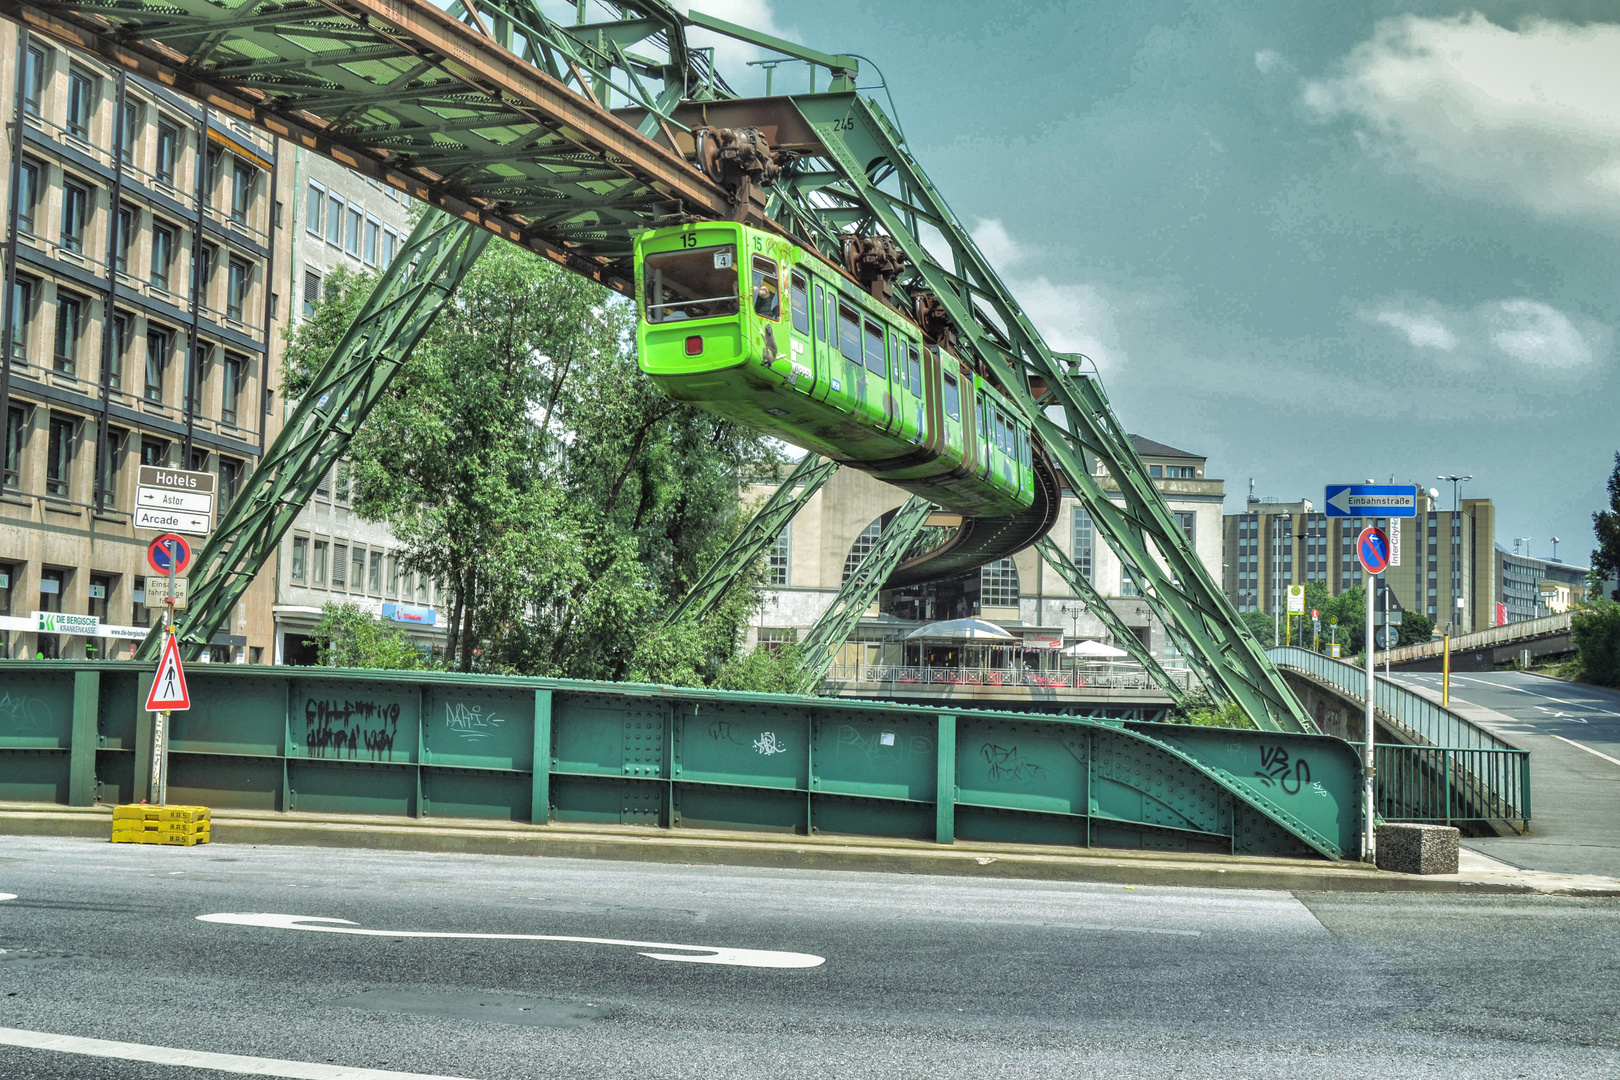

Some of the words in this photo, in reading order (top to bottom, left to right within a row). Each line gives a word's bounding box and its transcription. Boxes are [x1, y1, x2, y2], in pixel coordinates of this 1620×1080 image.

[833, 117, 854, 132] 245
[680, 232, 697, 248] 15
[752, 235, 763, 252] 15
[719, 256, 727, 267] 4
[155, 471, 198, 488] Hotels
[162, 494, 184, 506] Astor
[1348, 496, 1410, 505] Einbahnstraße
[141, 513, 179, 526] Arcade
[56, 615, 66, 624] DIE
[66, 616, 97, 626] BERGISCHE
[59, 624, 97, 634] KRANKENKASSE
